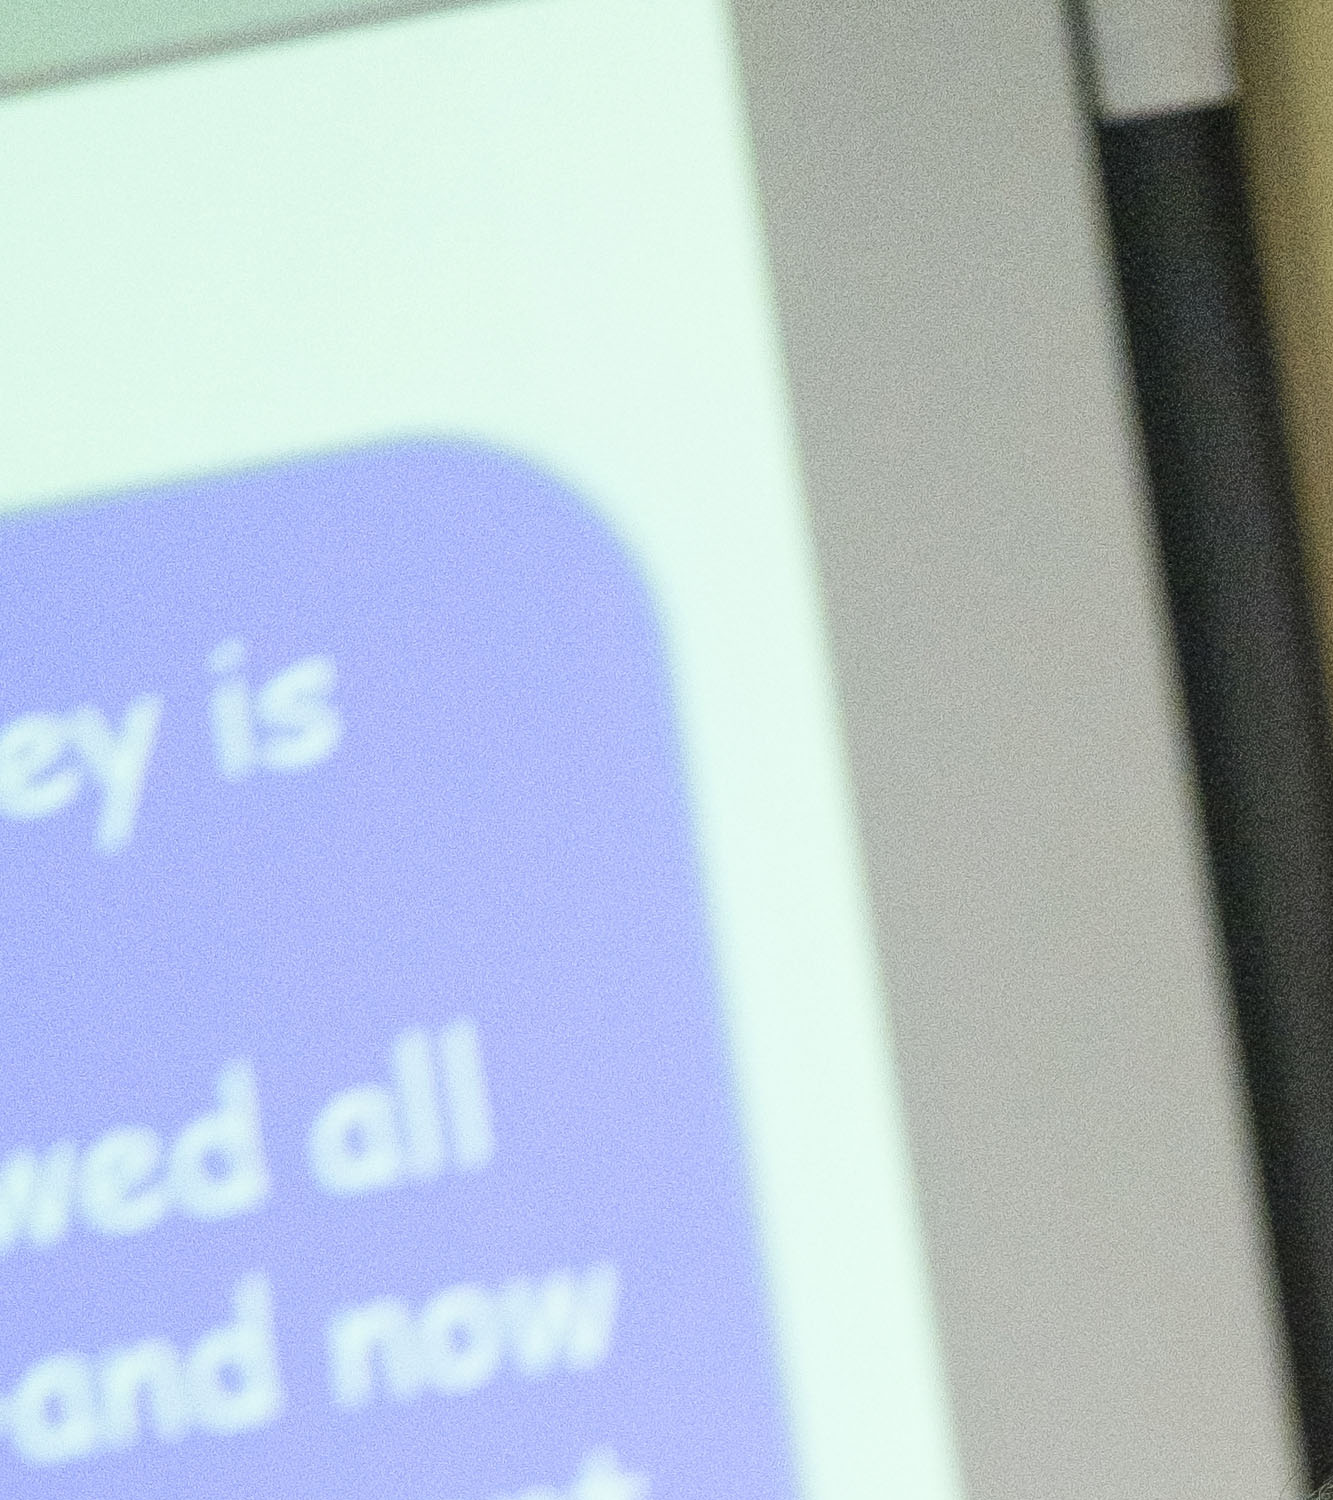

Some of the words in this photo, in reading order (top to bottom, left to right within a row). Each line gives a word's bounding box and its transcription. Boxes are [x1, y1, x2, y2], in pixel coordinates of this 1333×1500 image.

[205, 636, 346, 783] is
[305, 1016, 498, 1198] all
[328, 1260, 622, 1412] now
